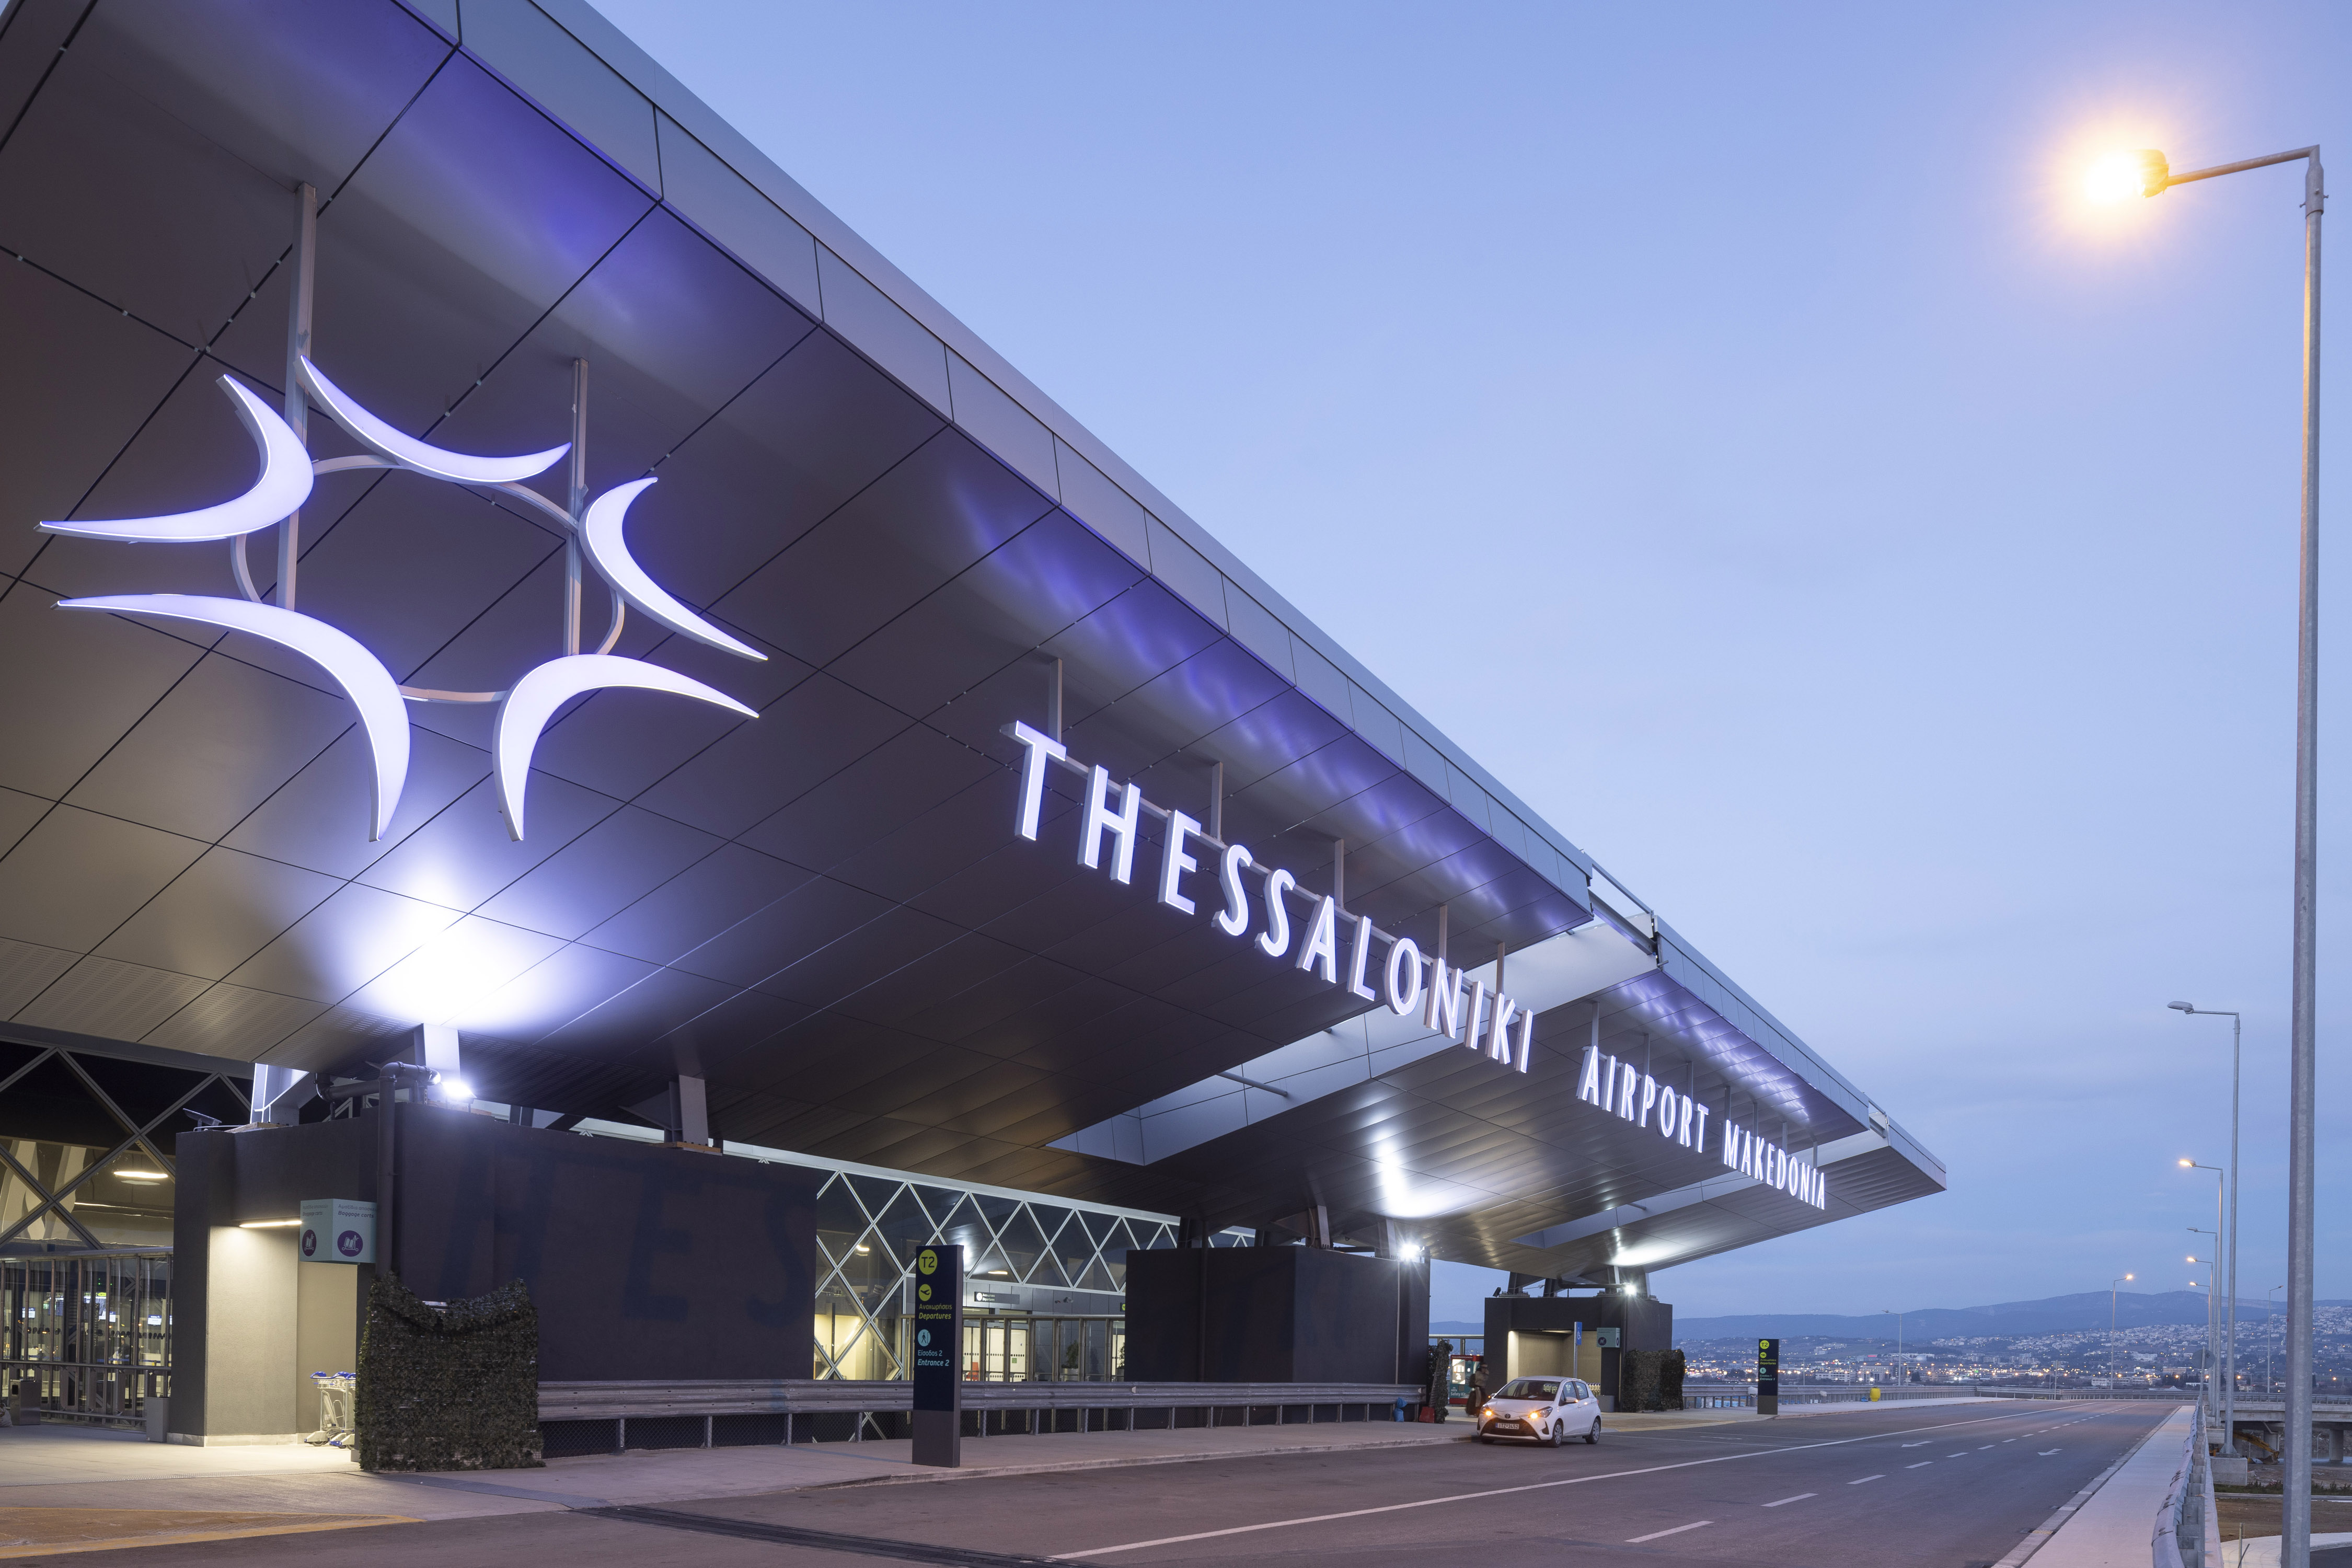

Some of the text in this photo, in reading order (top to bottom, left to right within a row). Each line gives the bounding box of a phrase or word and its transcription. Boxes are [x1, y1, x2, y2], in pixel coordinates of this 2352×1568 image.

[1014, 720, 1825, 1210] THESSALONIKI AIRPORT MAKEDONIA
[921, 1256, 935, 1268] T2
[918, 1312, 951, 1320] Departures
